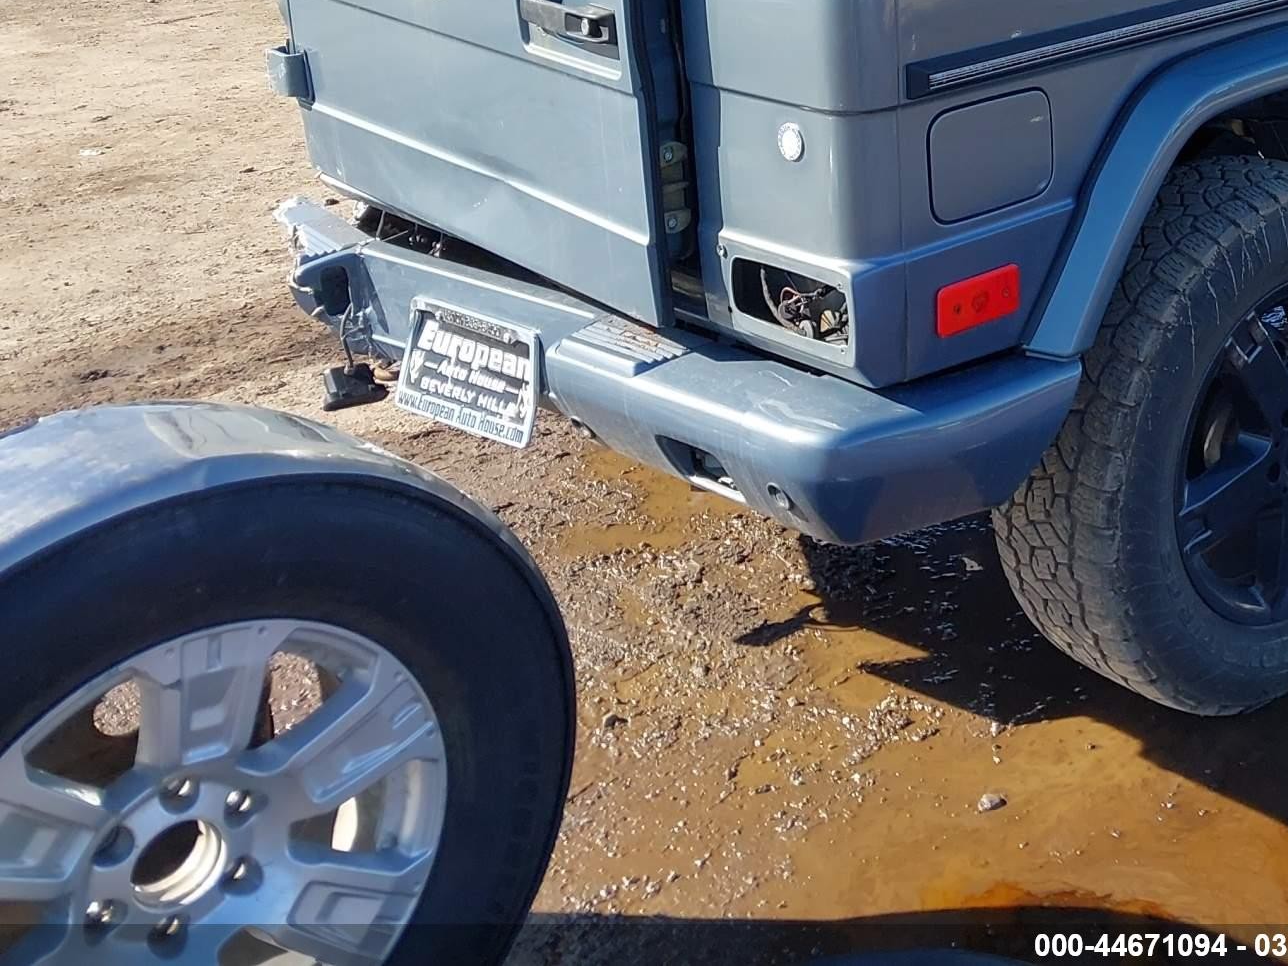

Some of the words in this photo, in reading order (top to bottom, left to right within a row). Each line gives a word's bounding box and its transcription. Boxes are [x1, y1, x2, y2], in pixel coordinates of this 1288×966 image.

[417, 319, 530, 384] European
[437, 359, 468, 381] Auto
[420, 376, 476, 403] BEVERLY
